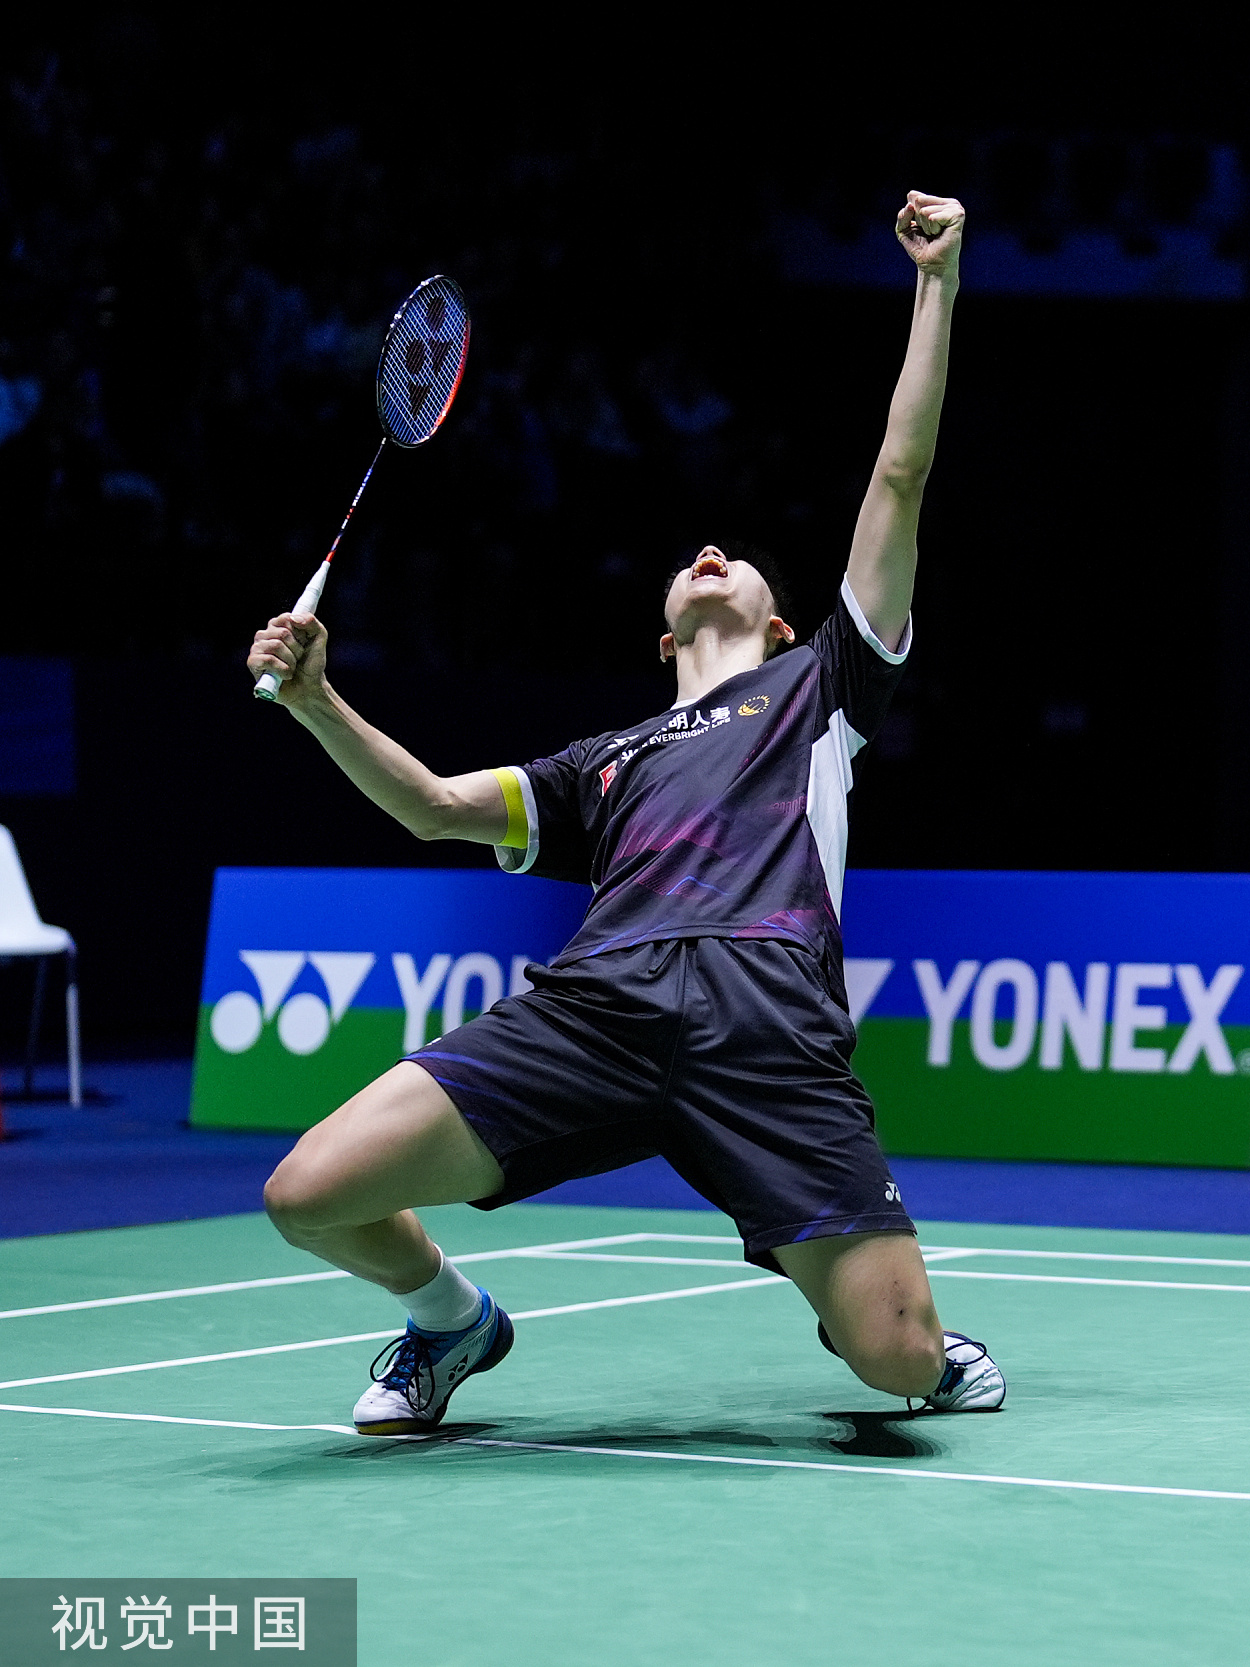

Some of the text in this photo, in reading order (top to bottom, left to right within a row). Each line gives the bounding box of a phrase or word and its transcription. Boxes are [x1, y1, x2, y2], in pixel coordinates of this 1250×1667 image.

[649, 725, 710, 745] EVERBRIGHT
[655, 706, 731, 735] 明人寿
[911, 958, 1245, 1076] YONEX
